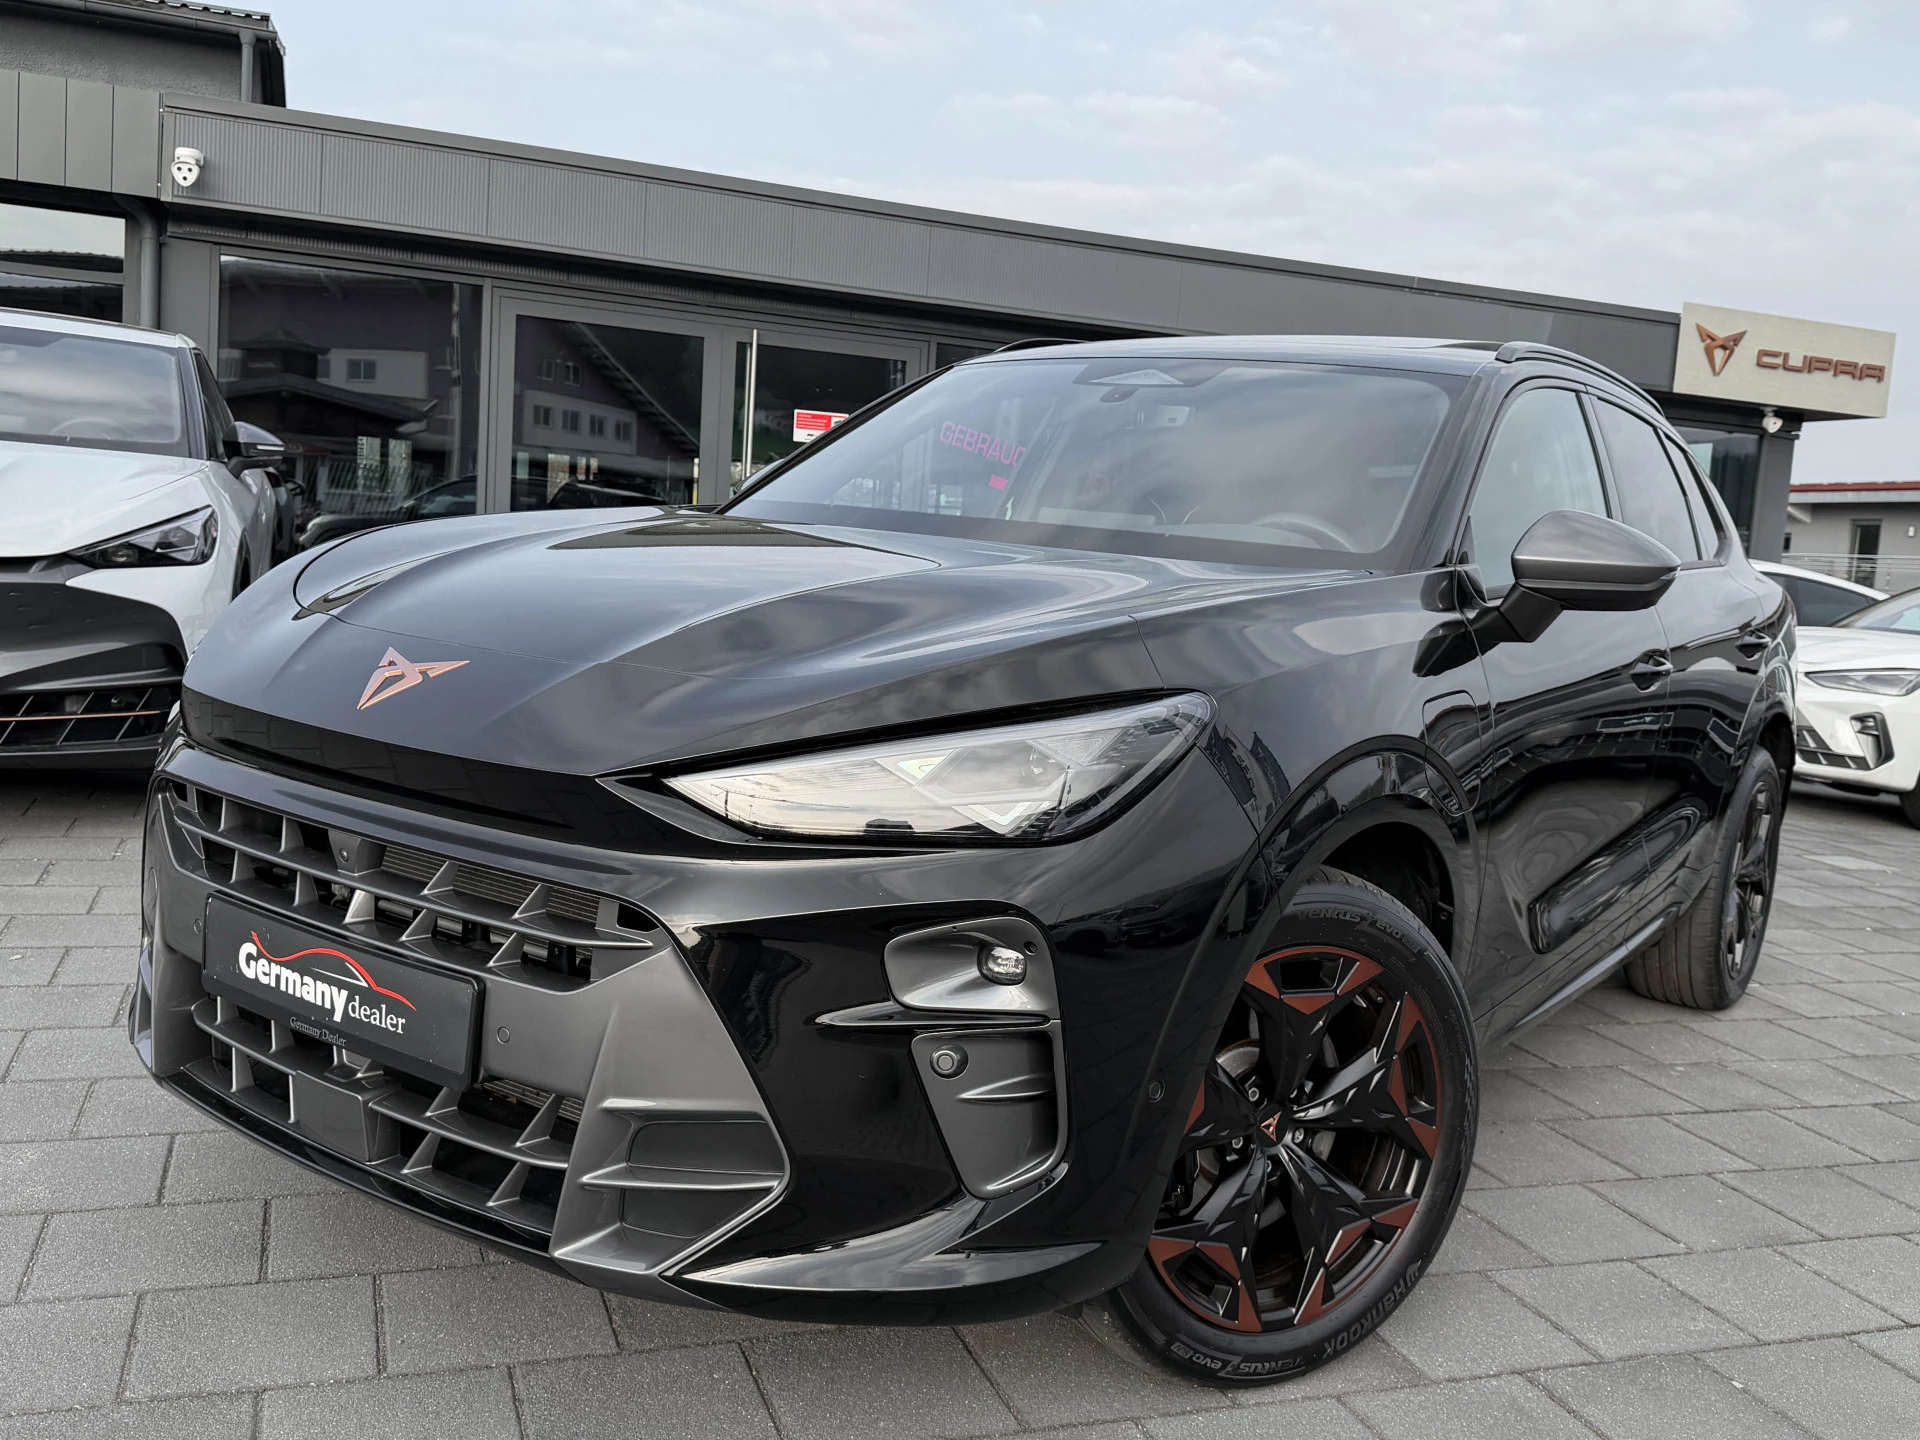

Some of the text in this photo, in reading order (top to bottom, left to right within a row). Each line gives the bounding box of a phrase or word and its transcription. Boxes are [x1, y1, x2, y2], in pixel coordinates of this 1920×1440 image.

[1756, 348, 1886, 384] CUPRA
[238, 941, 406, 1035] Germany dealer
[289, 1015, 347, 1048] Germany Dealer
